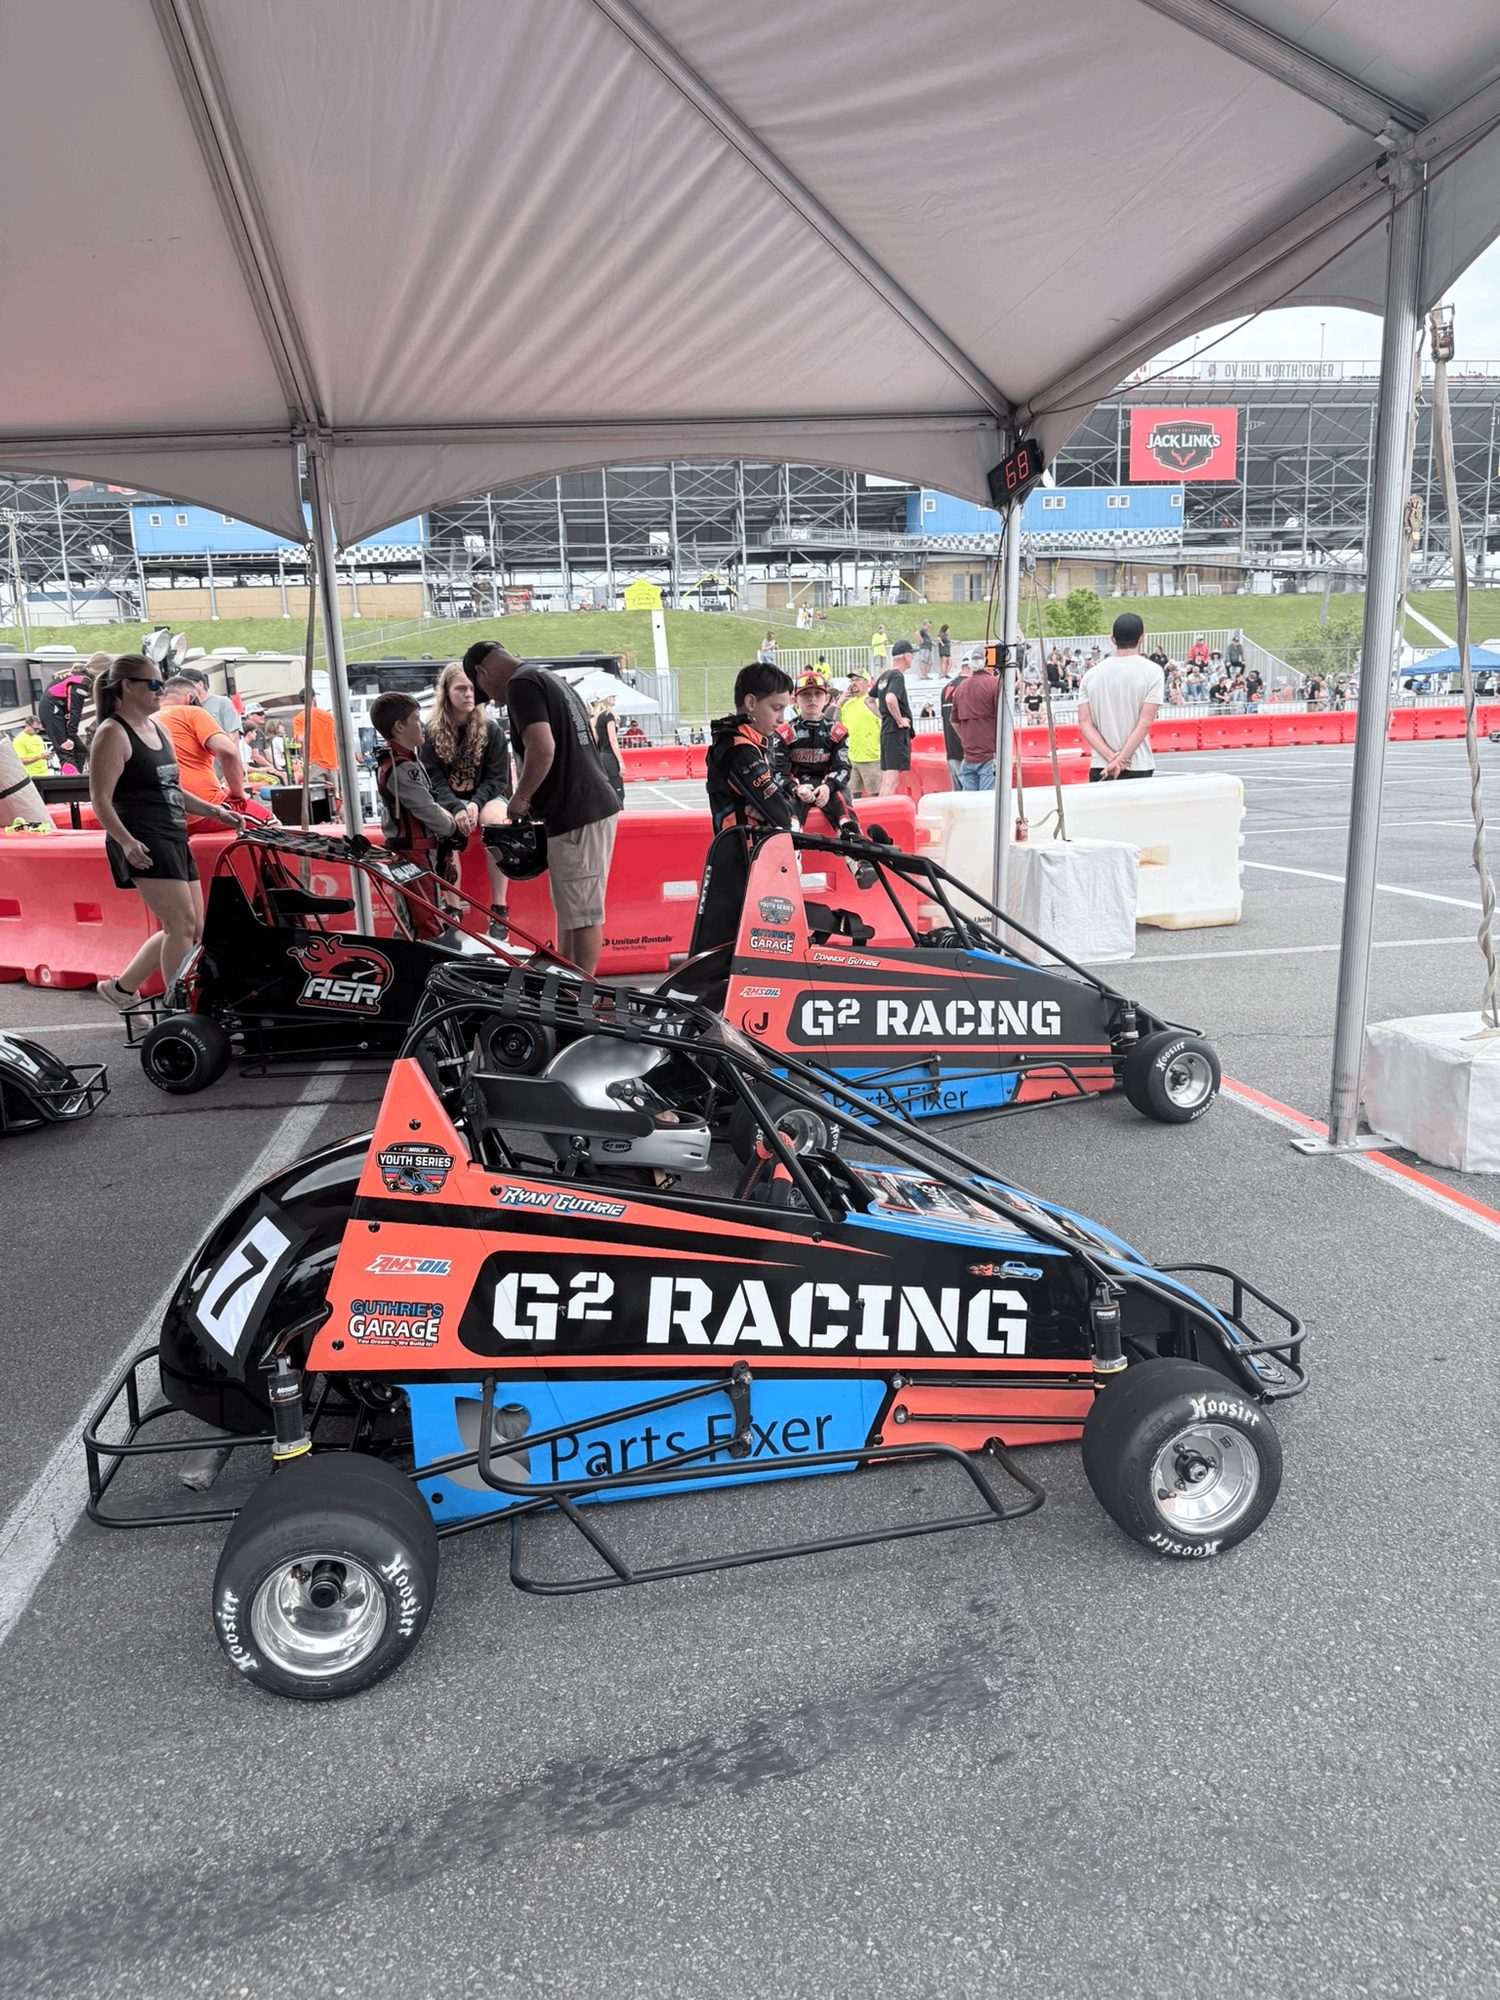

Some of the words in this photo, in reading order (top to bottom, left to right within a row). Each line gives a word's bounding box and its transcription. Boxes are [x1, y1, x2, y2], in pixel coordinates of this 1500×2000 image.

[1241, 363, 1262, 377] HILL
[1265, 363, 1298, 377] NORTH
[1299, 363, 1335, 377] TOWER
[1146, 432, 1181, 449] JACK
[1005, 450, 1029, 489] 68
[611, 937, 640, 946] United
[641, 935, 672, 944] Rentals
[750, 936, 793, 952] GARAGE
[304, 978, 381, 1005] ASR
[876, 999, 1061, 1036] RACING
[1156, 1041, 1185, 1072] Hoosier
[380, 1154, 413, 1166] YOUTH
[415, 1156, 452, 1168] SERIES
[500, 1185, 553, 1207] RYAN
[552, 1193, 627, 1217] GUTHRIE
[210, 1240, 269, 1321] 7
[366, 1254, 451, 1277] AMSOIL
[350, 1299, 443, 1318] GUTHRIE'S
[646, 1275, 1029, 1355] RACING
[349, 1315, 441, 1343] GARAGE
[1189, 1395, 1260, 1427] Hoosier
[707, 1414, 833, 1464] Fxer
[380, 1553, 422, 1638] Hoosier
[217, 1589, 259, 1672] Hoosier
